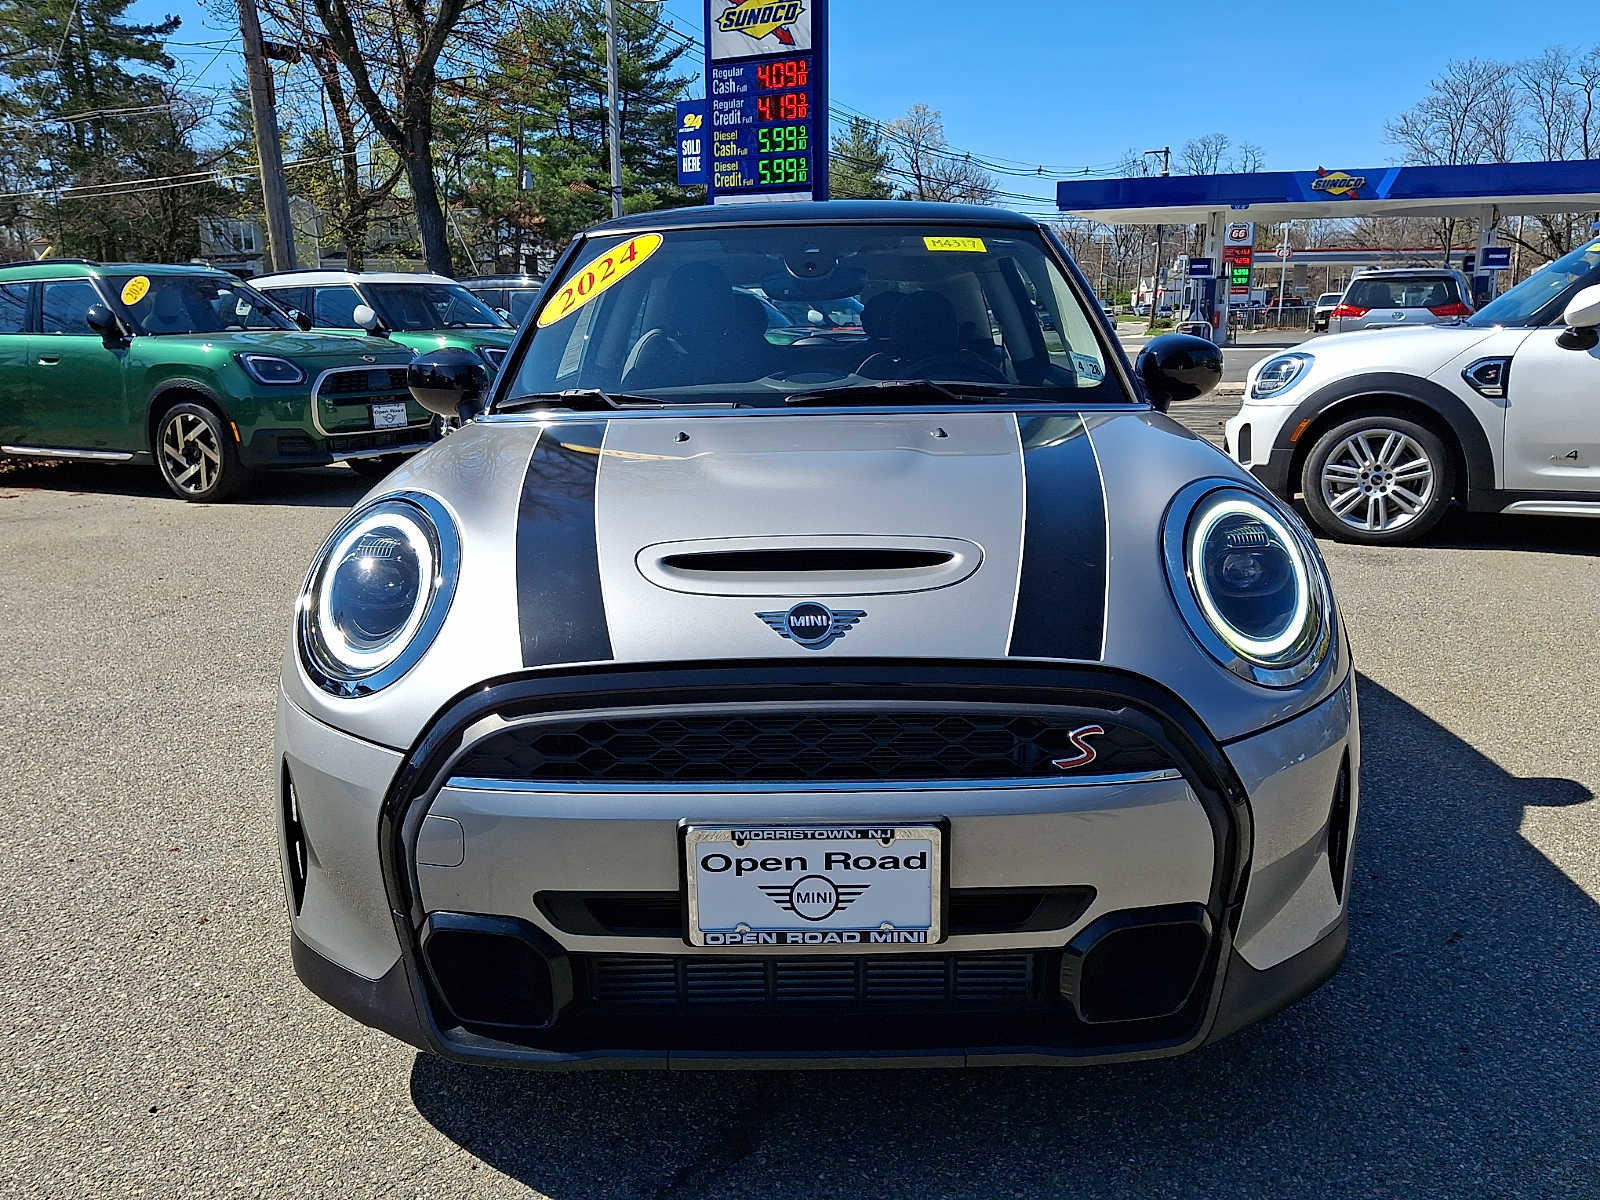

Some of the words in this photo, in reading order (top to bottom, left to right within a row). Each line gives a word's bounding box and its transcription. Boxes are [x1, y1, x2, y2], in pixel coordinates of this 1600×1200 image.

[723, 3, 798, 28] SUNOCO
[712, 67, 744, 80] Regular
[712, 79, 735, 94] Cash
[736, 84, 748, 93] Full
[713, 99, 744, 111] Regular
[713, 109, 741, 126] Credit
[742, 115, 753, 124] Full
[713, 130, 738, 141] Diesel
[759, 126, 797, 153] 5.99
[681, 139, 701, 155] SOLD
[713, 141, 737, 157] Cash
[737, 148, 748, 156] Full
[682, 156, 701, 173] HERE
[714, 161, 738, 172] Diesel
[759, 158, 797, 185] 5.99
[714, 171, 742, 188] Credit
[1313, 178, 1363, 189] SUNOCO
[1231, 229, 1246, 238] 66
[558, 240, 638, 315] 2024
[790, 615, 828, 627] MINI
[1052, 725, 1105, 770] S
[734, 830, 862, 840] MORRISTOWN,
[868, 829, 892, 839] NJ
[700, 853, 808, 877] Open
[824, 851, 927, 871] Road
[796, 891, 833, 904] MINI
[705, 932, 777, 944] OPEN
[786, 932, 861, 944] ROAD
[870, 931, 926, 943] MINI
